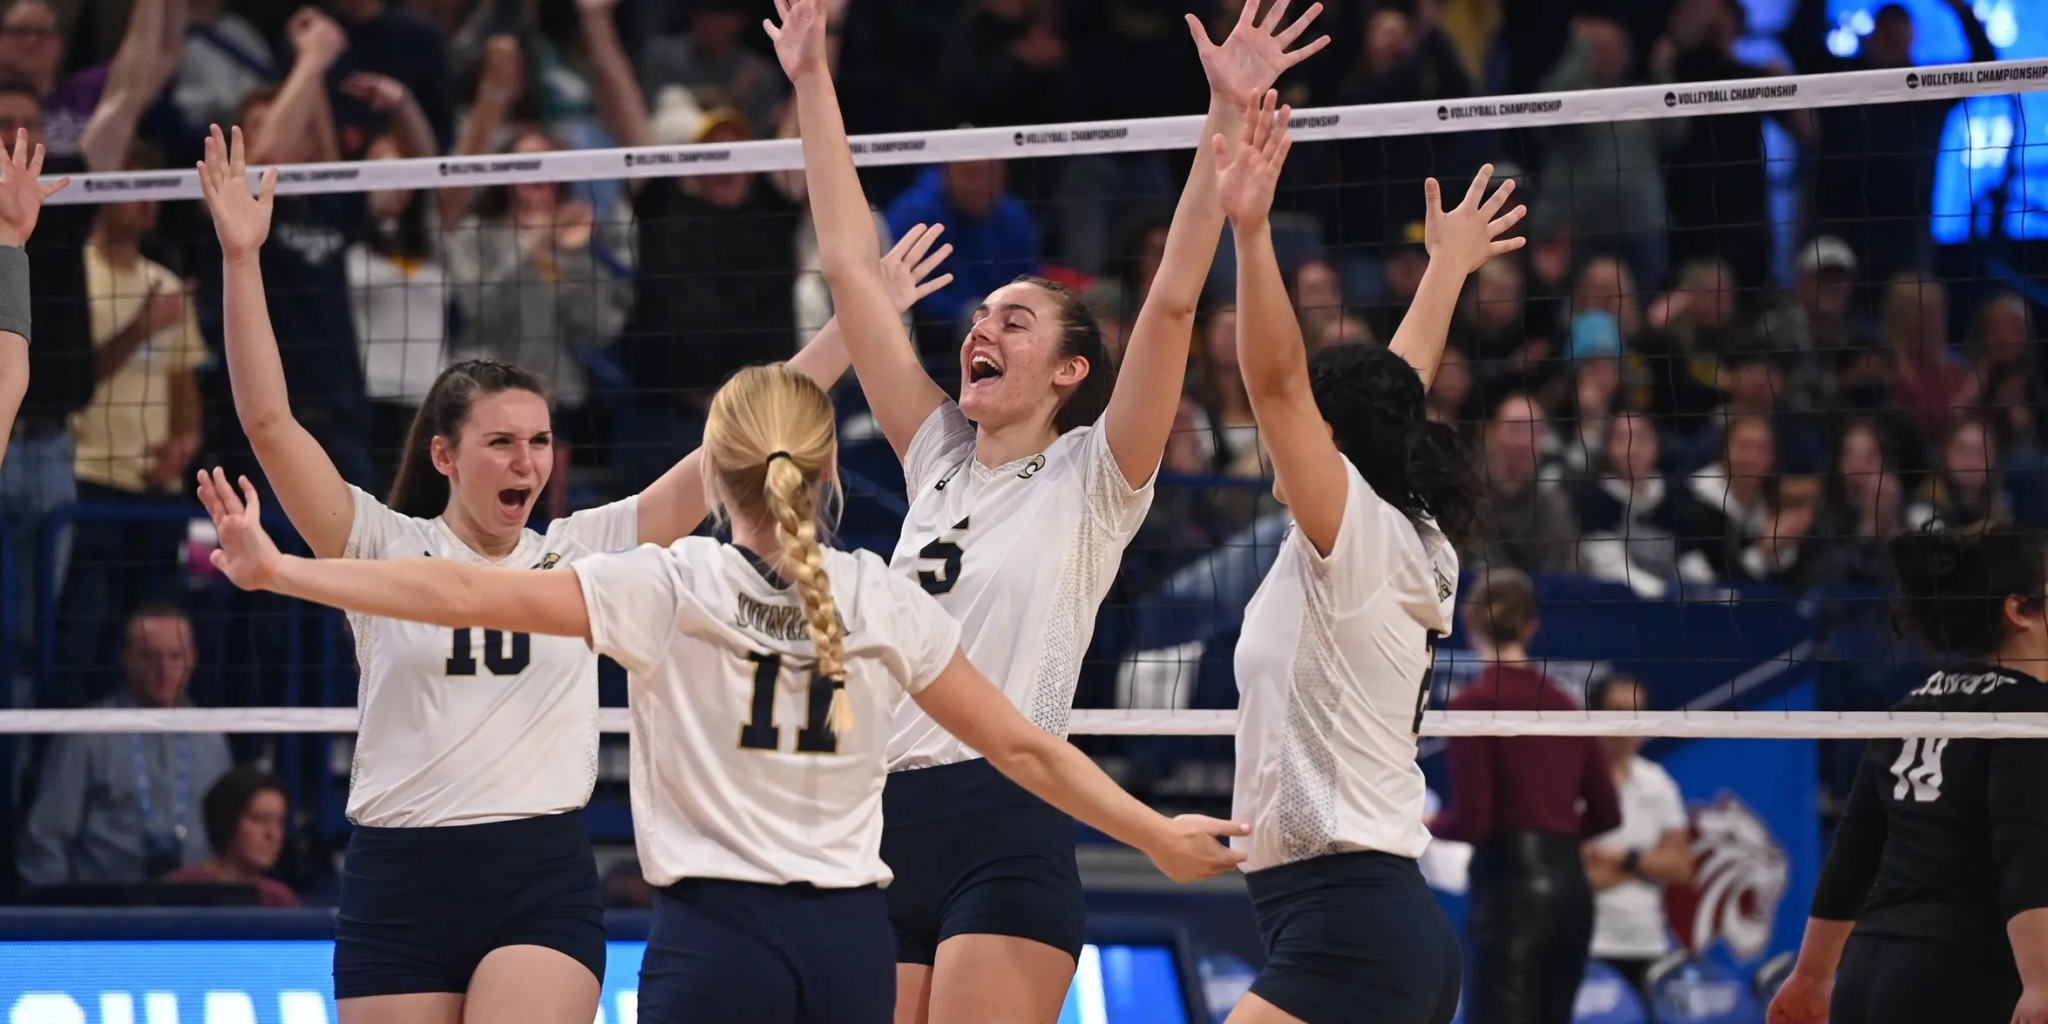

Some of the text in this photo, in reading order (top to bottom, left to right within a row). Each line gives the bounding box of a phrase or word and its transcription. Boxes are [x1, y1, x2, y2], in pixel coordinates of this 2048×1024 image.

[1678, 84, 1798, 105] VOLLEYBALL CHAMPIONSHIP
[1921, 65, 2048, 87] VOLLEYBALL CHAMPIONSHIP
[1450, 99, 1562, 119] VOLLEYBALL CHAMPIONSHIP
[915, 514, 971, 596] 5
[734, 591, 850, 641] JUNI
[444, 626, 532, 678] 10
[737, 649, 842, 755] 11
